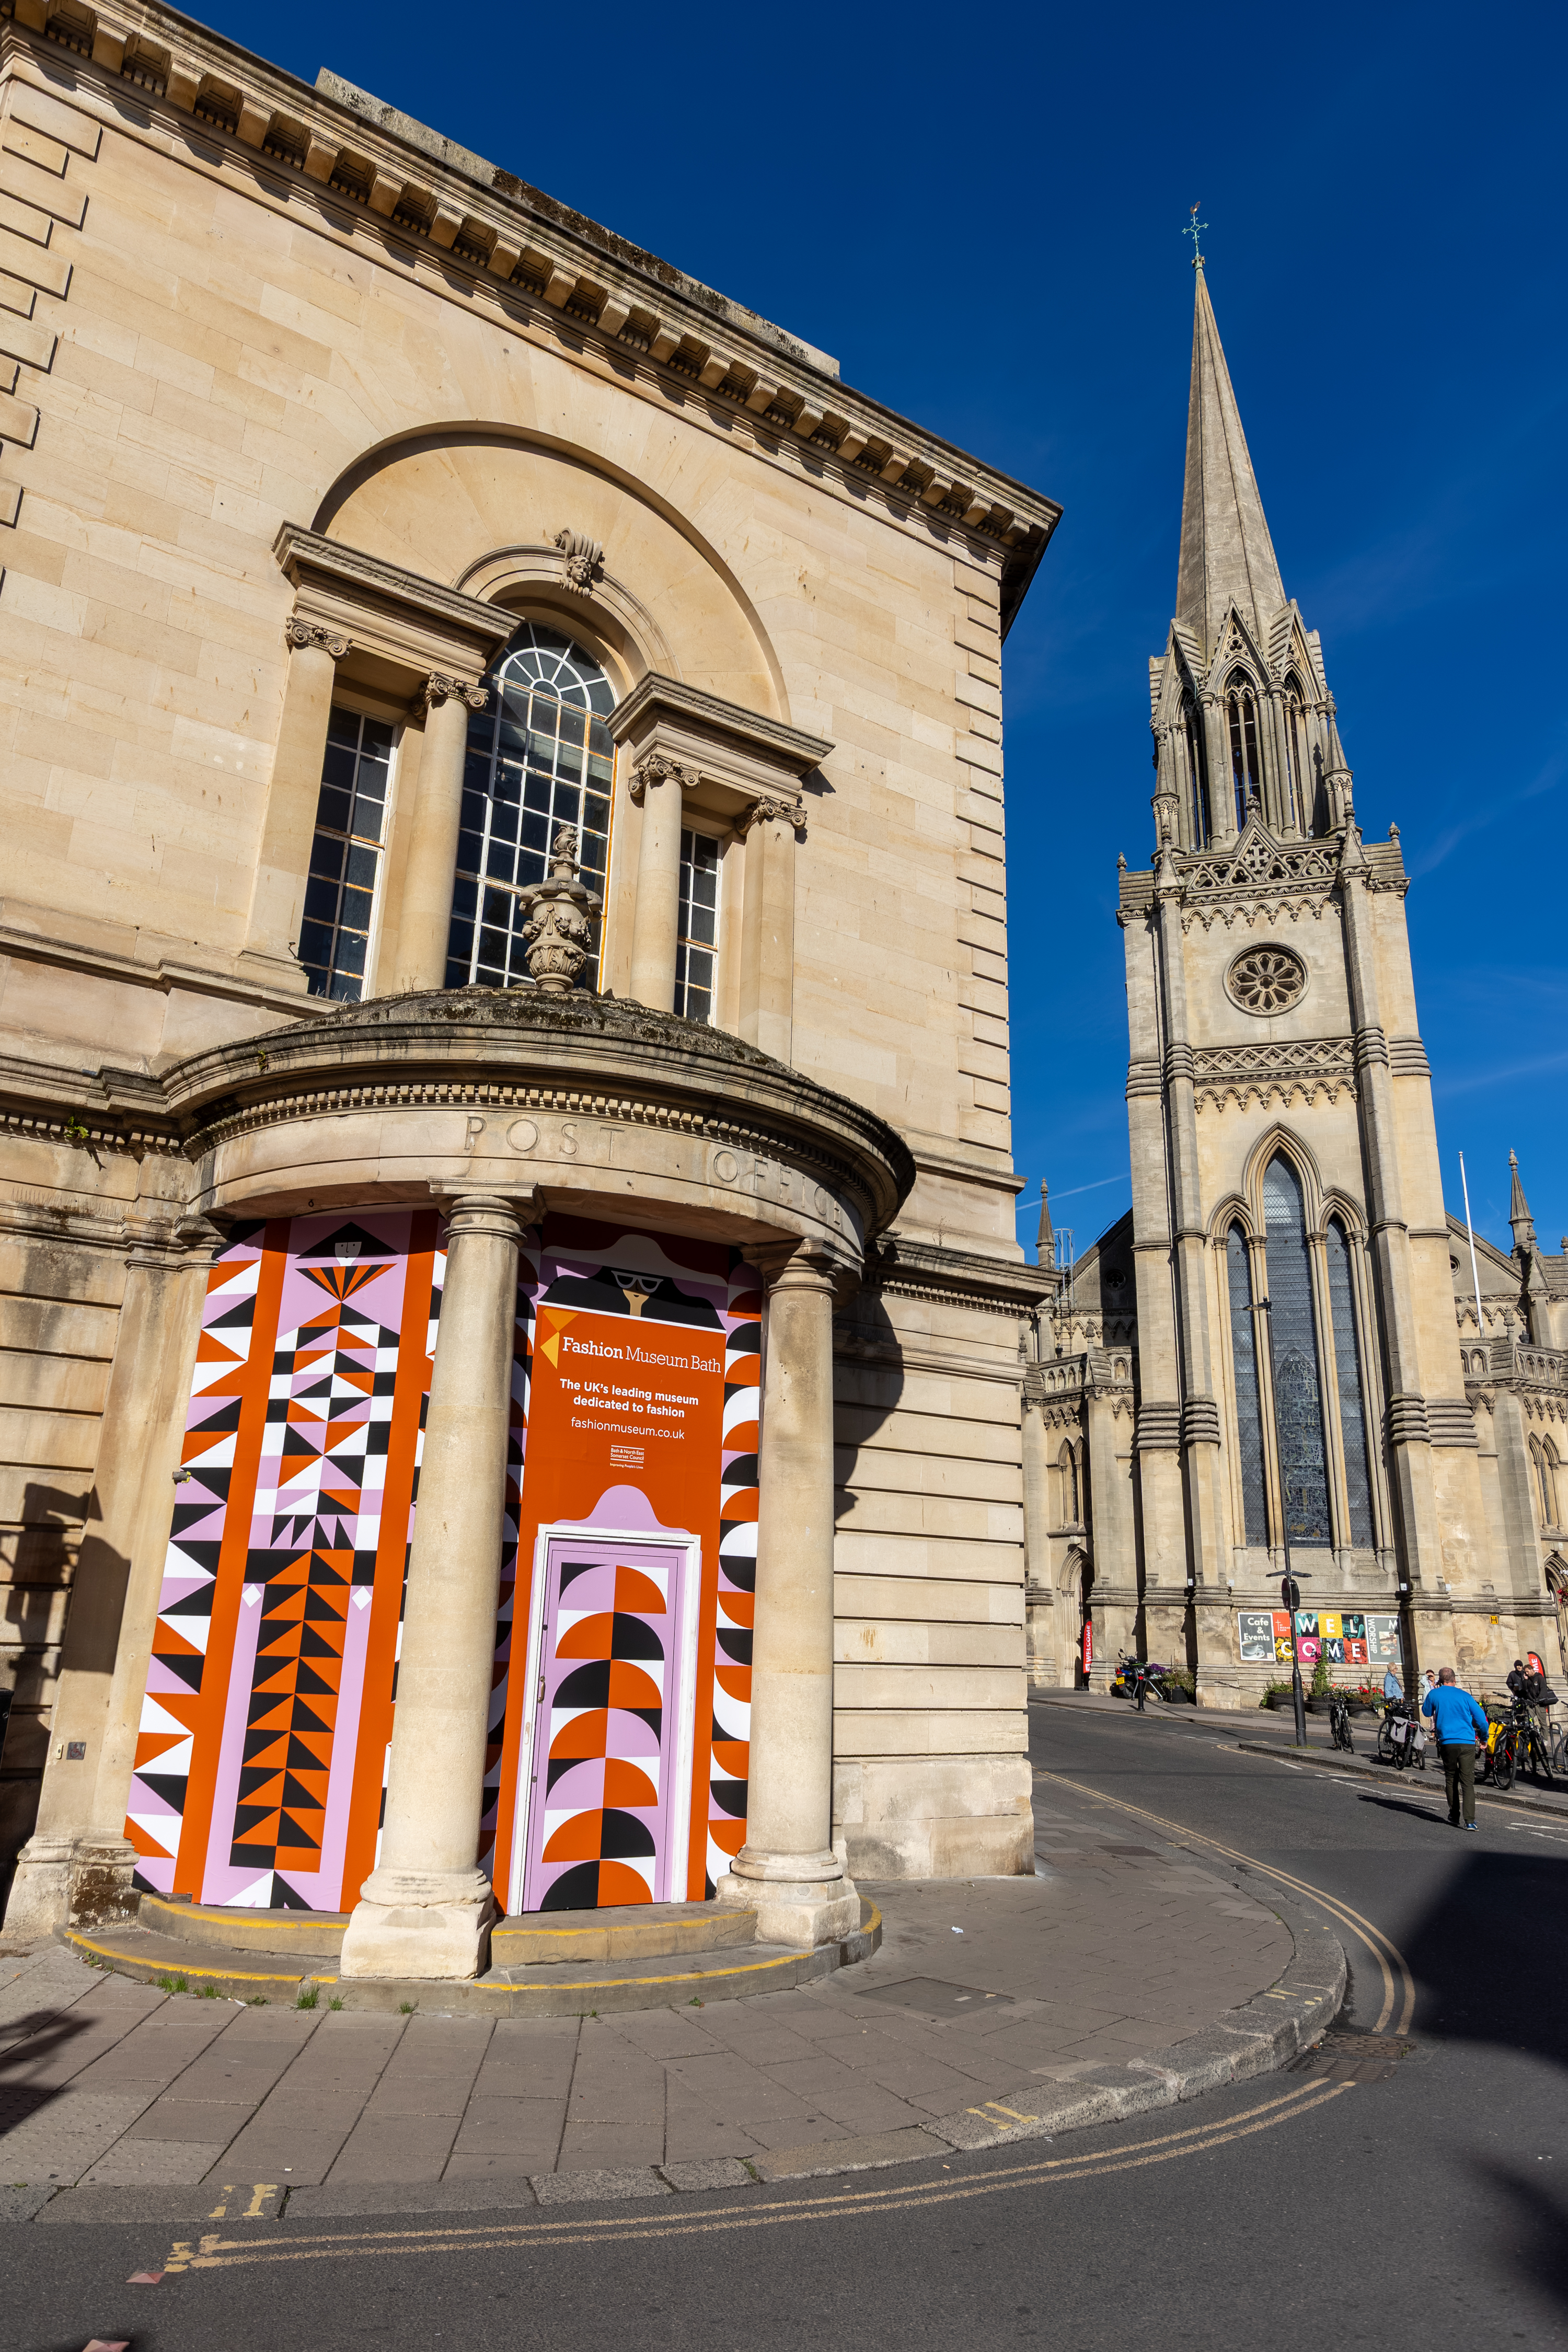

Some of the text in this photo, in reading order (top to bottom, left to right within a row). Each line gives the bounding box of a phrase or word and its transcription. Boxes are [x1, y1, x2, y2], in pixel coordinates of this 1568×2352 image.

[464, 1115, 842, 1227] POST OFFICE
[562, 1337, 721, 1373] Fashion Museum Bath
[560, 1378, 698, 1405] The UK’s leading museum
[573, 1396, 684, 1417] dedicated to fashion
[571, 1417, 684, 1439] fashionmuseum.co.uk
[1247, 1617, 1269, 1626] Cafe
[1243, 1633, 1271, 1641] Events
[1367, 1618, 1378, 1654] WORSHIP
